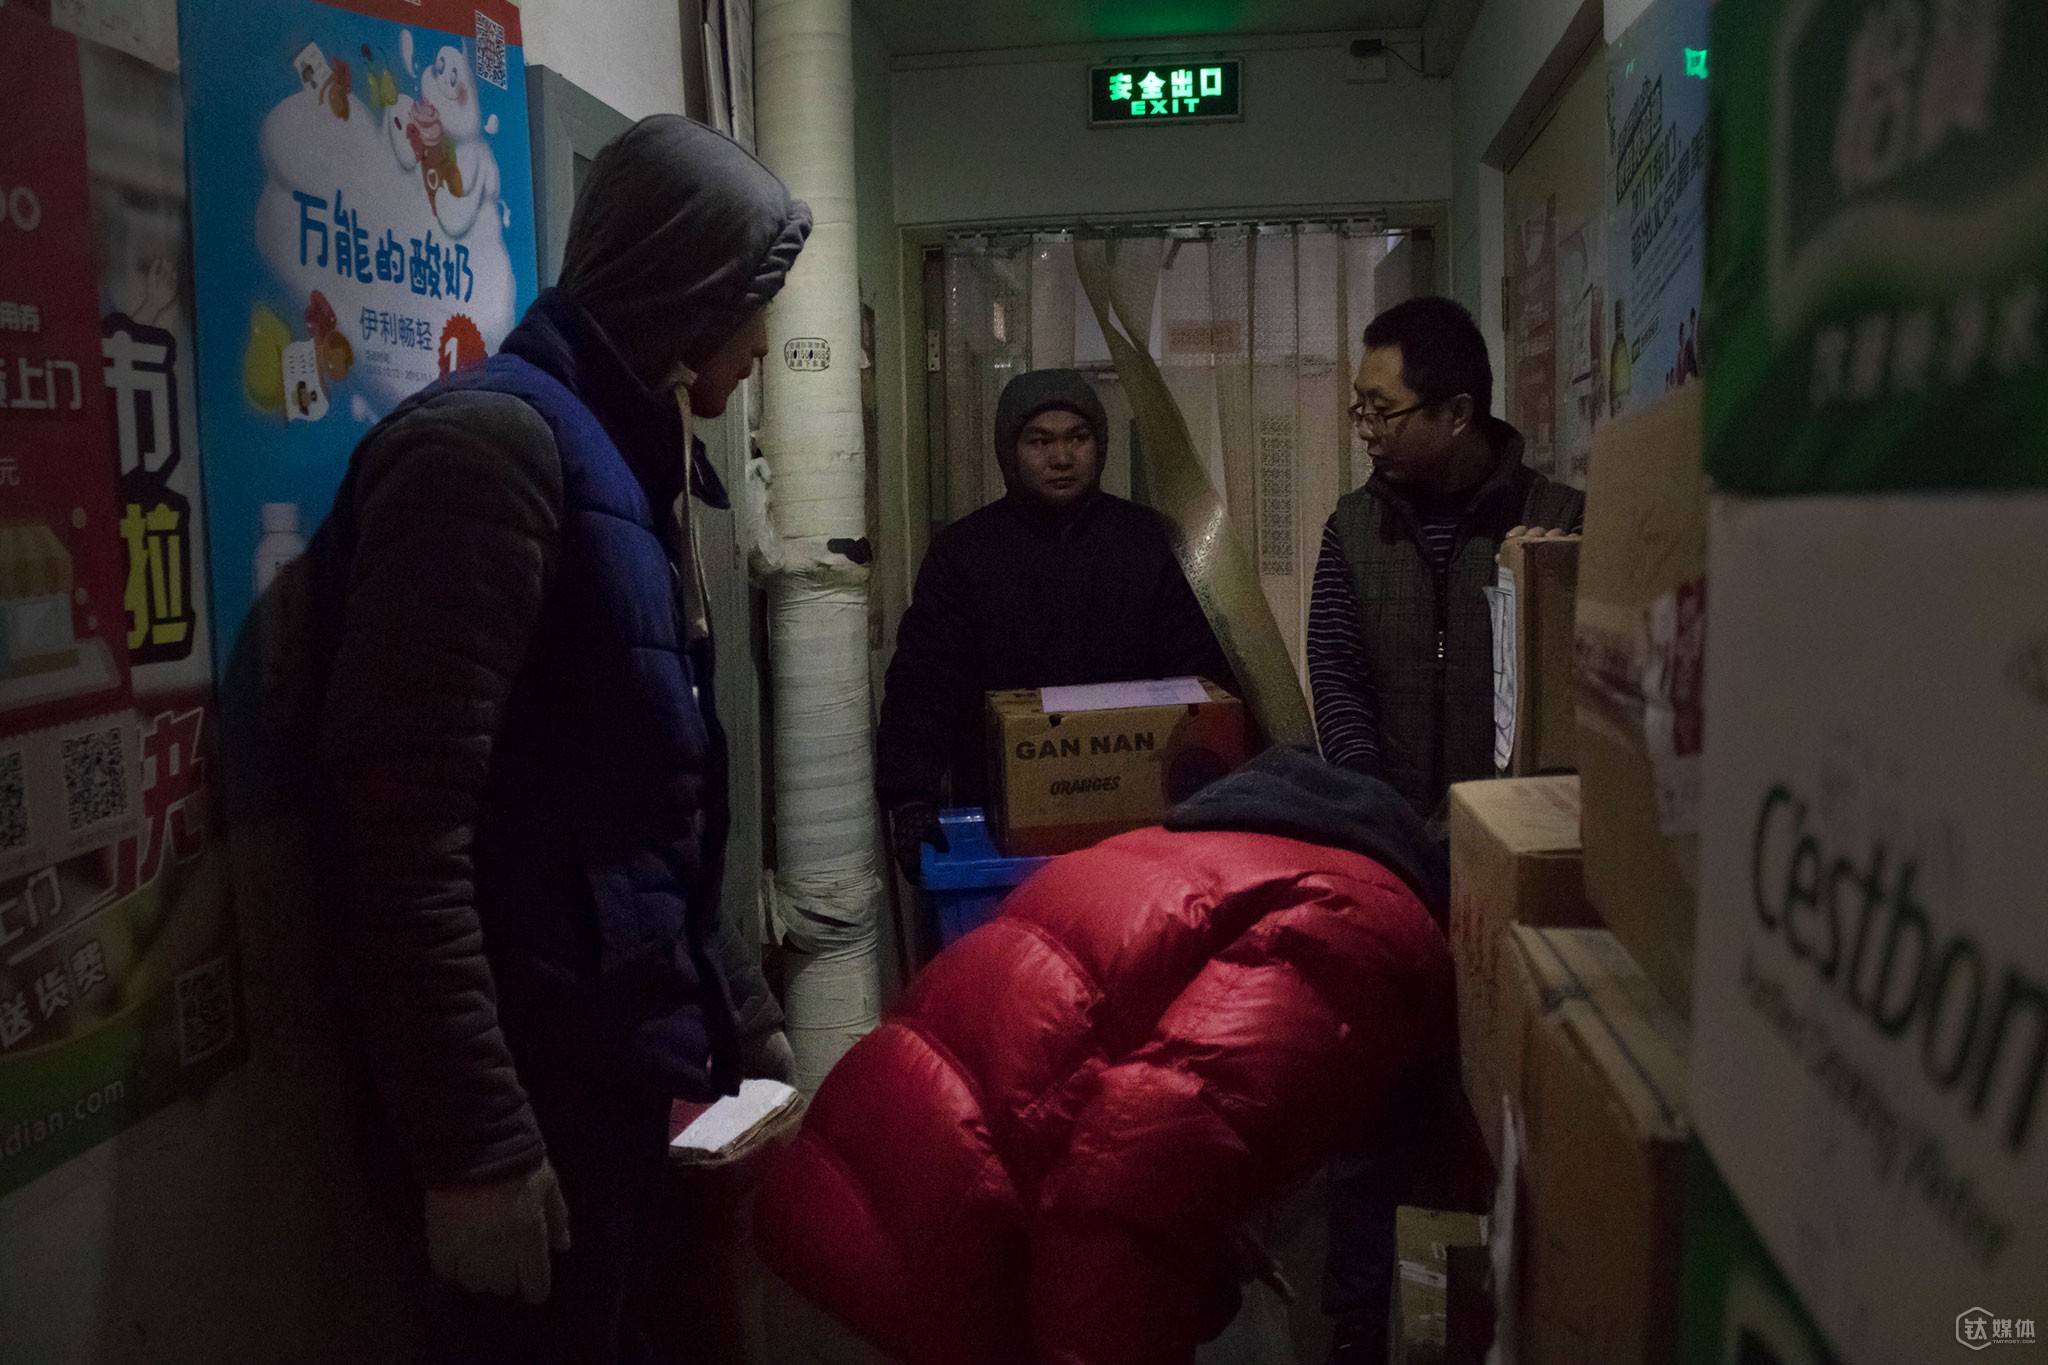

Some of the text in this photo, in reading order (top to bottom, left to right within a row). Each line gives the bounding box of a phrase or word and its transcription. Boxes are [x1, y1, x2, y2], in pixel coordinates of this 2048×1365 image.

[1108, 67, 1222, 101] 安全出口
[1130, 97, 1200, 116] EXIT
[0, 186, 41, 232] 0
[293, 189, 474, 303] 万能的酸奶
[360, 306, 433, 351] 伊利畅轻
[0, 356, 82, 410] 上门
[1016, 731, 1155, 760] GAN NAN
[1050, 776, 1121, 796] ORANGES
[0, 941, 107, 1049] 送货费
